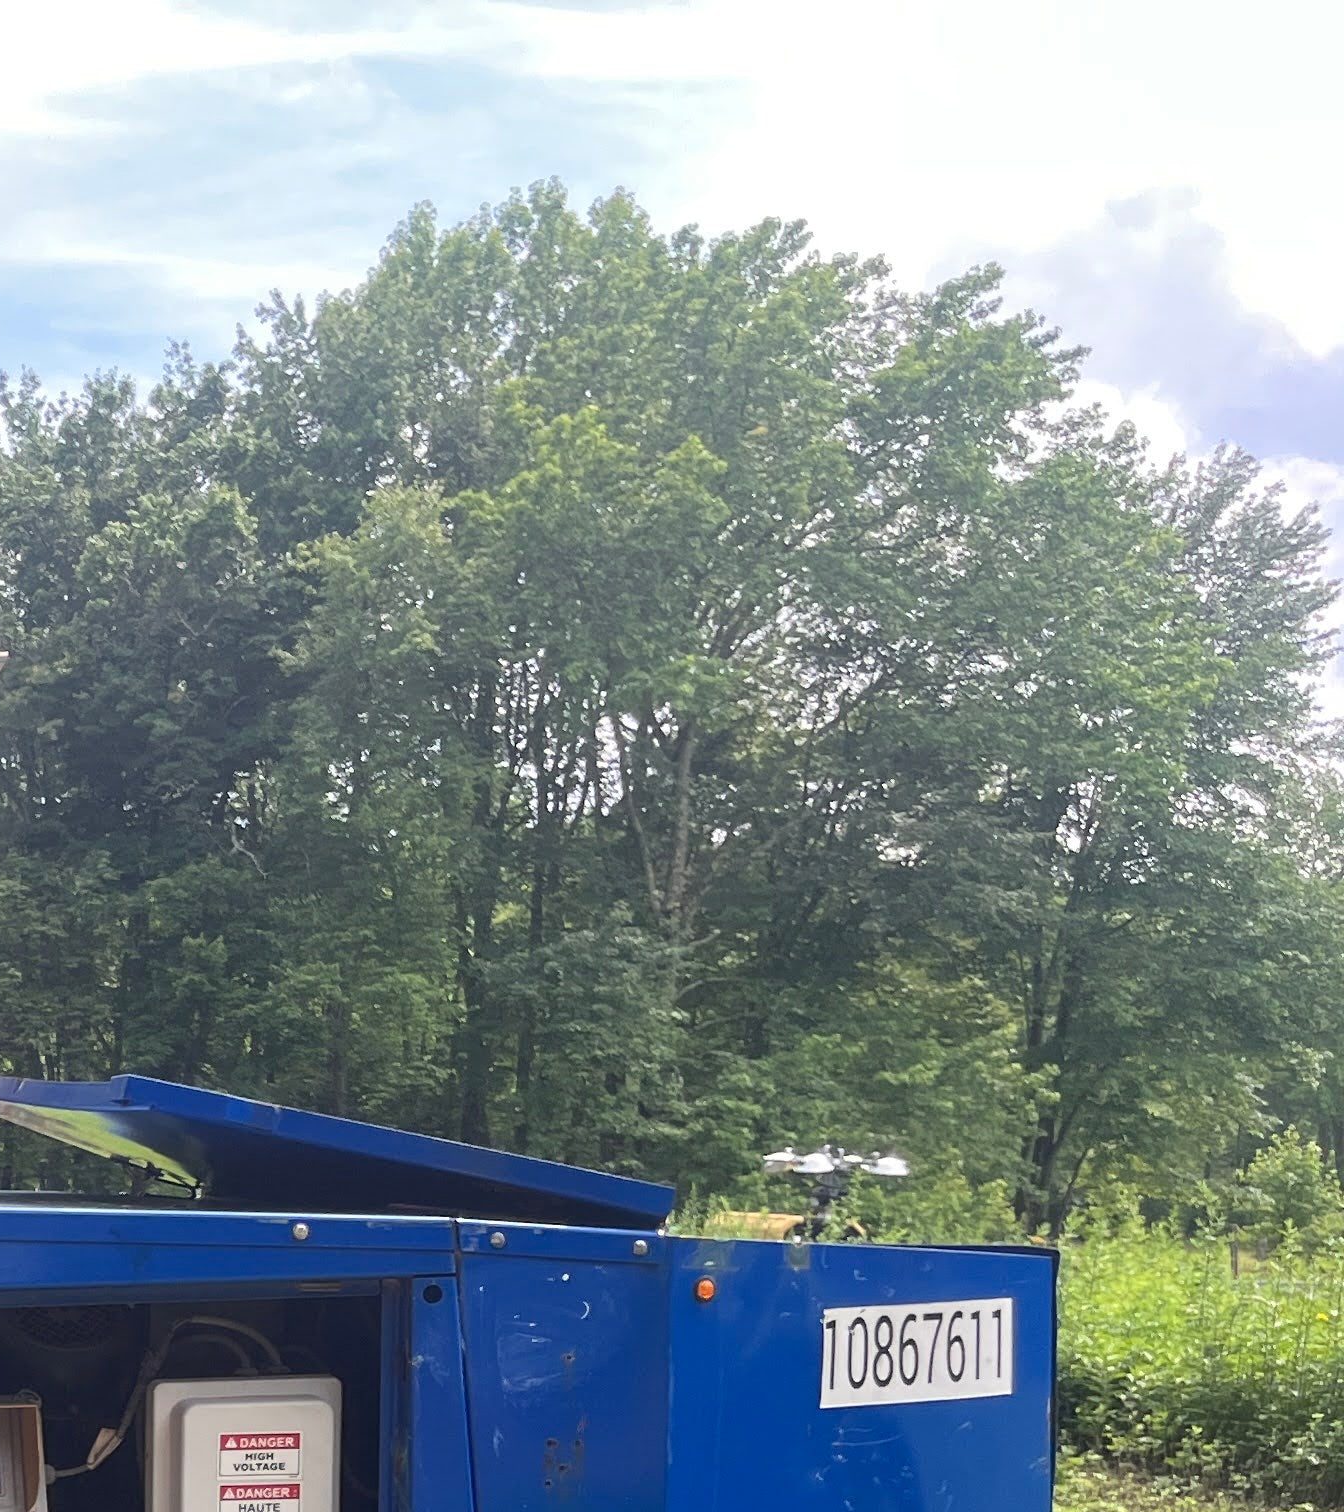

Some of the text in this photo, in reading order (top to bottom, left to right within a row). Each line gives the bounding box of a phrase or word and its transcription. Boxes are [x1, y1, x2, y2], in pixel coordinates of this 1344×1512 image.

[825, 1309, 1002, 1390] 10867611
[239, 1437, 294, 1448] DANGER
[245, 1452, 274, 1461] HIGH
[233, 1462, 286, 1471] VOLTAGE
[238, 1503, 281, 1512] HAUTE
